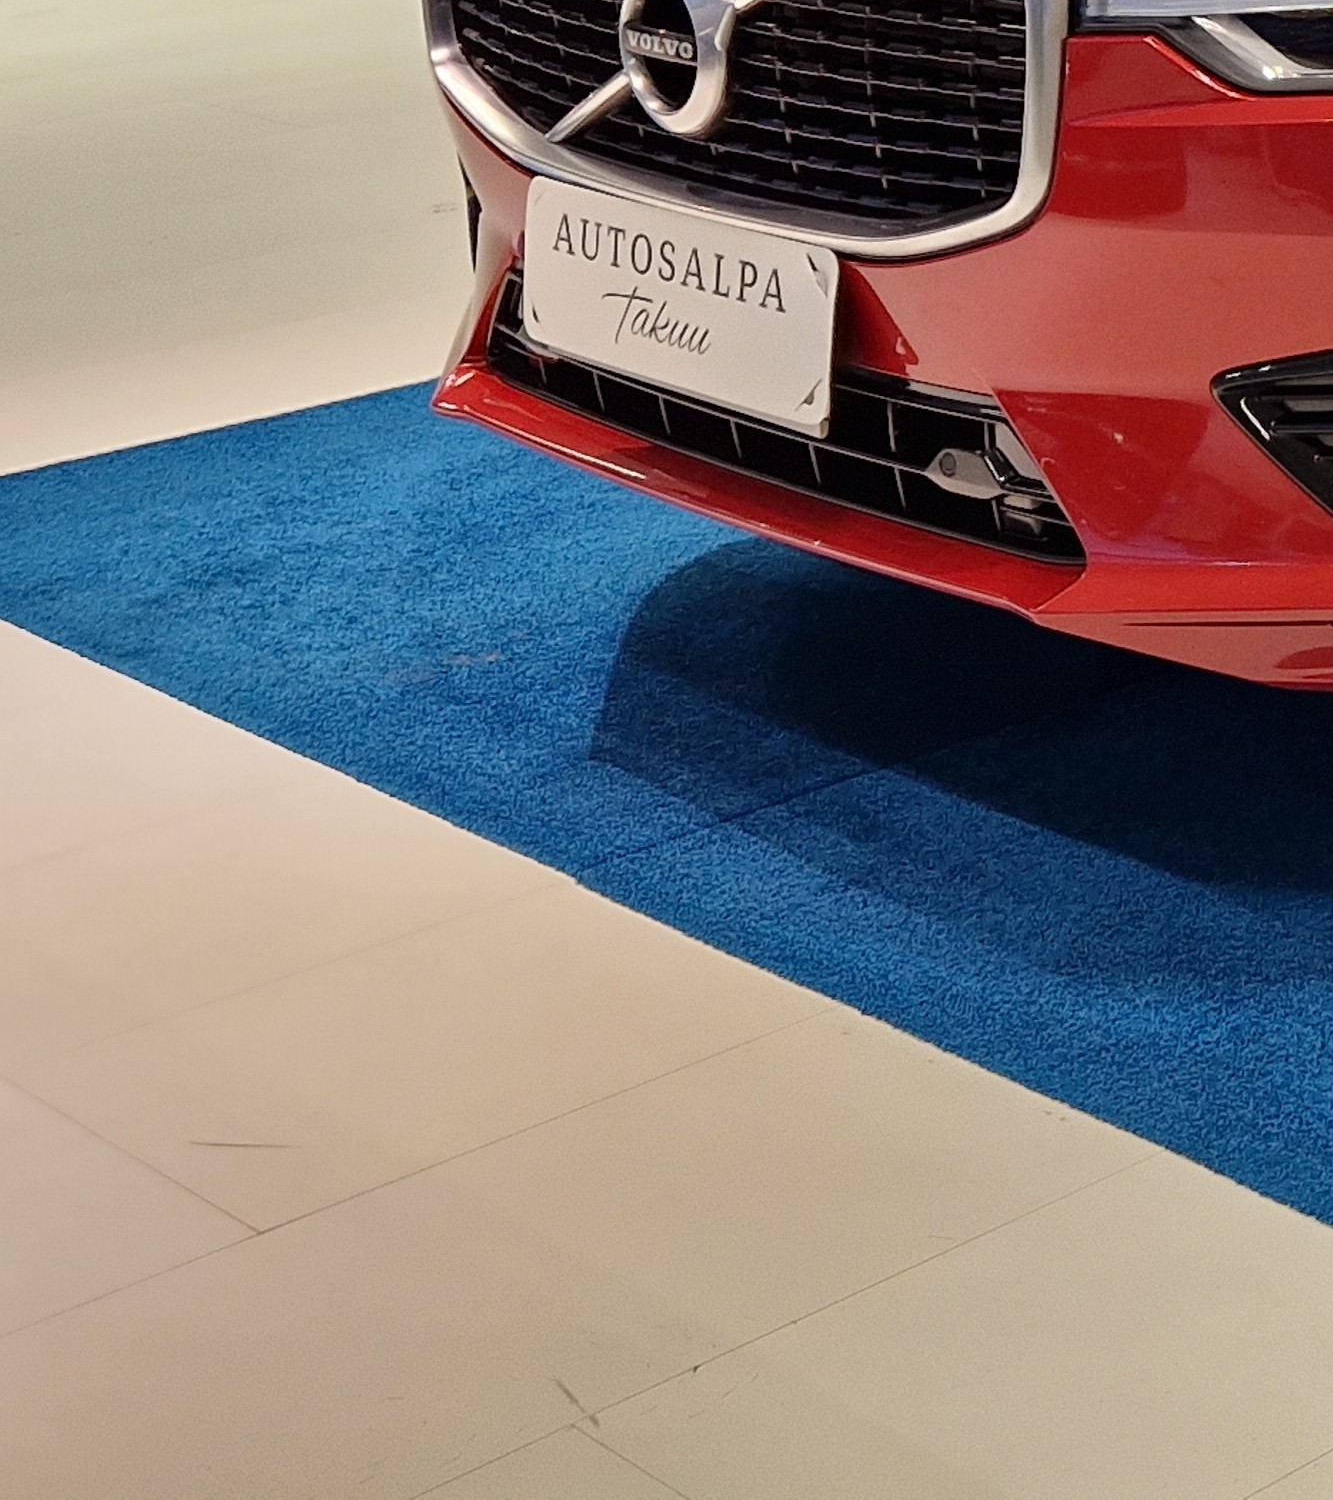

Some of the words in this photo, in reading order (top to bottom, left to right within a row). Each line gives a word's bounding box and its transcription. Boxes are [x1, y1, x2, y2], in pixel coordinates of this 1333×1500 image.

[626, 29, 694, 59] VOLVO
[552, 213, 787, 314] AUTOSALPA
[601, 285, 712, 355] Takuu
